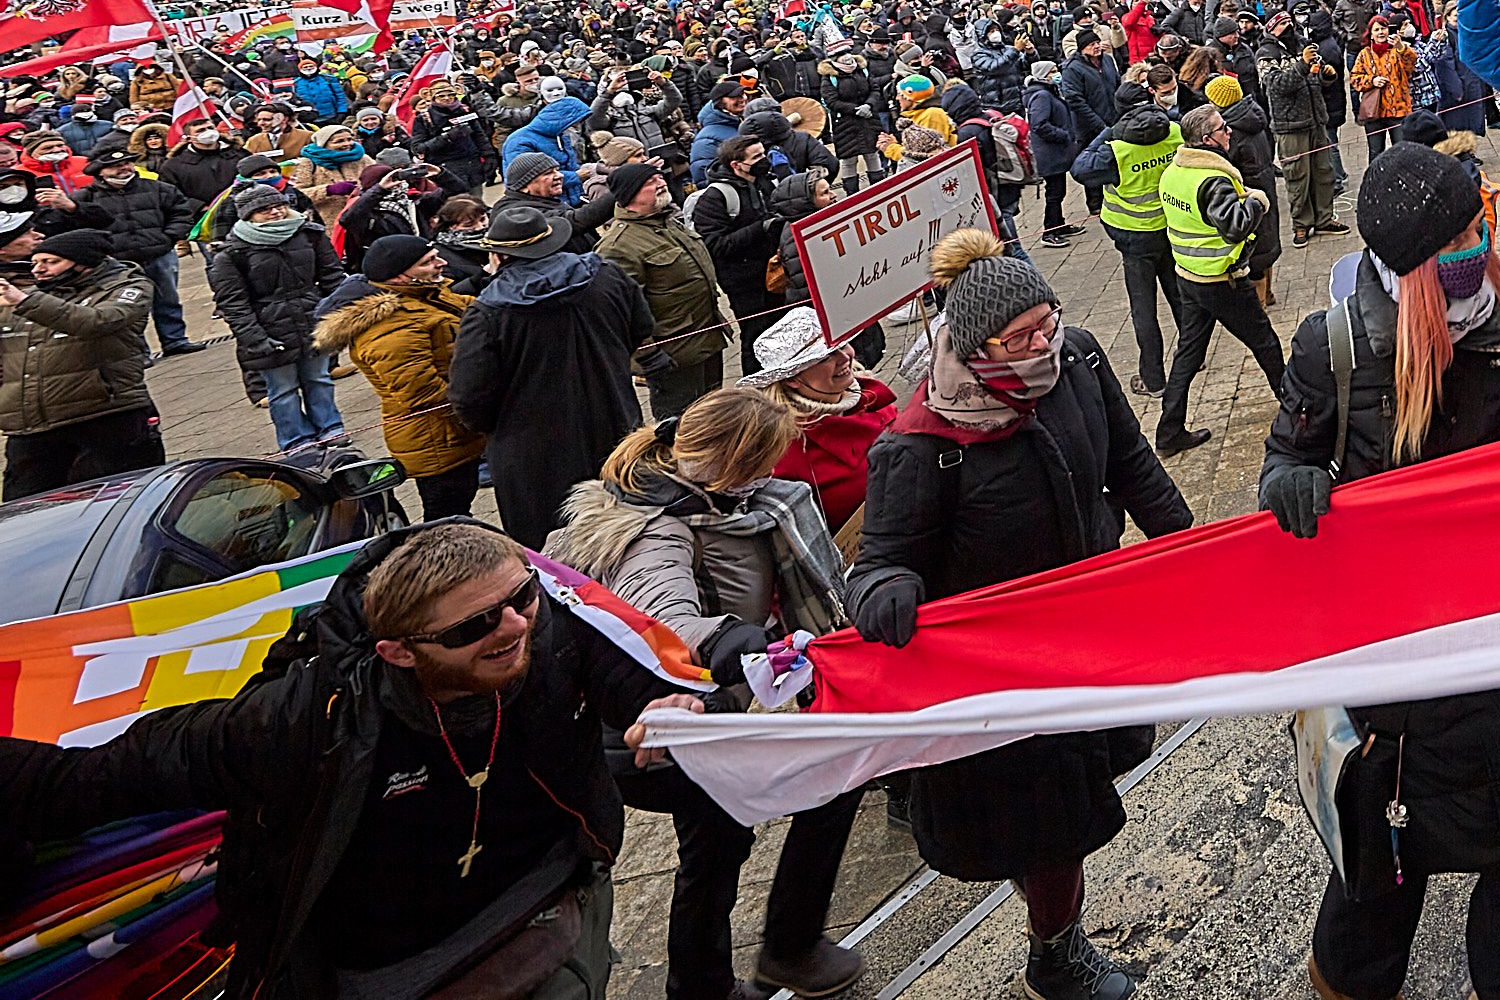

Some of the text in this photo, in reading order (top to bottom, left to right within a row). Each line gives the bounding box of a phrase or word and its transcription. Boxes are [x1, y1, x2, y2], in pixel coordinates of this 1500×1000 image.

[301, 13, 343, 26] Kurz
[407, 0, 449, 14] weg!
[1162, 191, 1192, 213] ORDNER
[821, 194, 921, 258] TIROL
